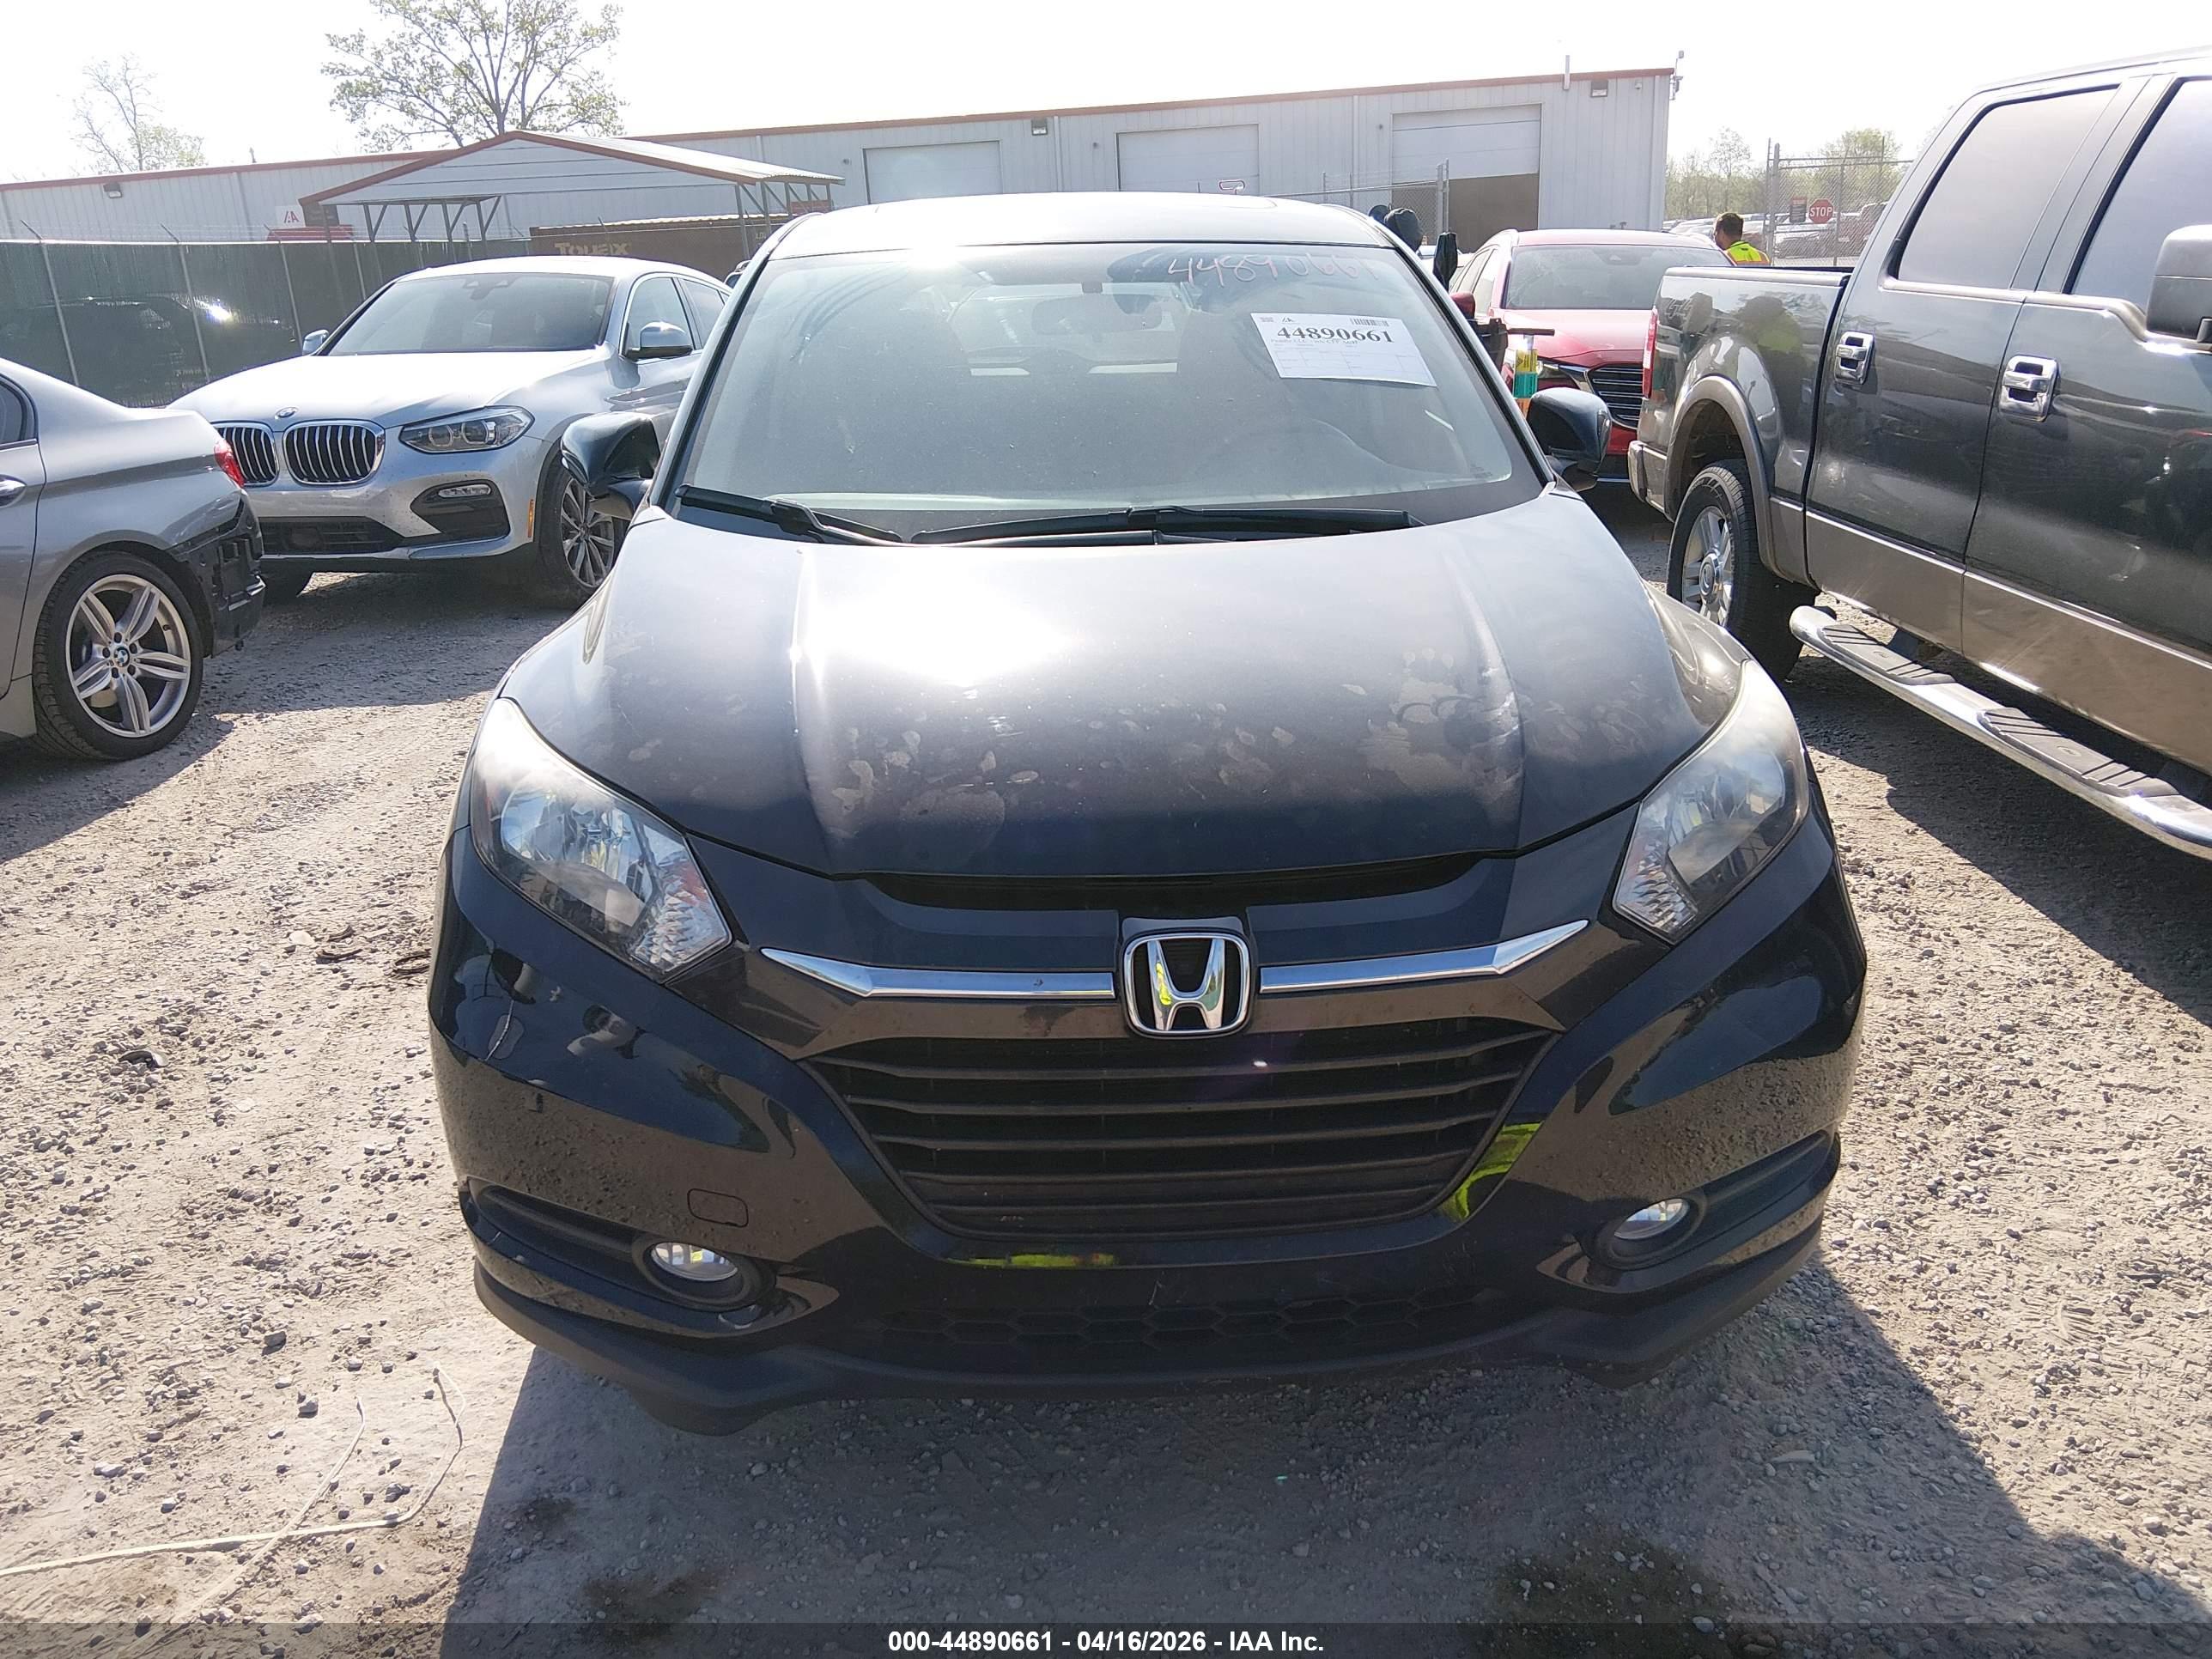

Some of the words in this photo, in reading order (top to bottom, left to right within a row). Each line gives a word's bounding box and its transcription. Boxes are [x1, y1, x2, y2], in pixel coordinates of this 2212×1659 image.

[1809, 206, 1833, 217] STOP
[1168, 252, 1378, 288] 44890661
[1277, 325, 1395, 343] 44890661
